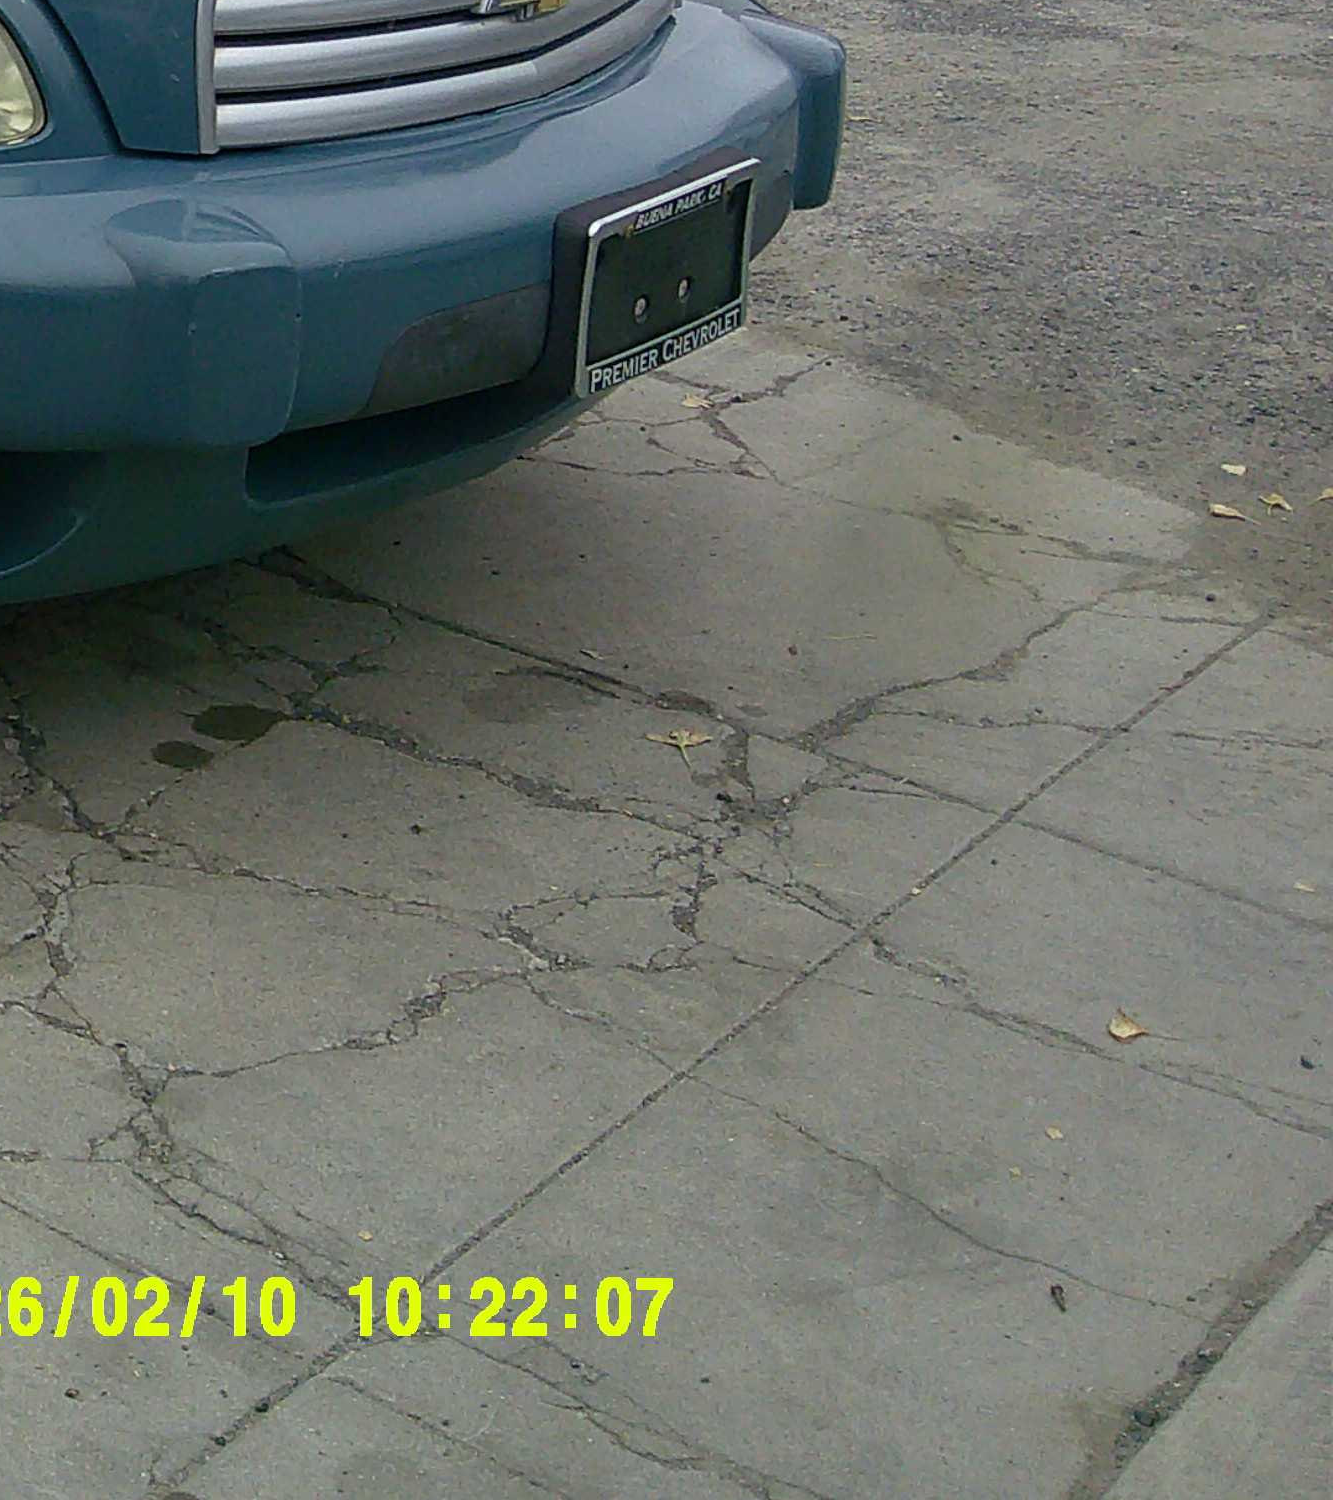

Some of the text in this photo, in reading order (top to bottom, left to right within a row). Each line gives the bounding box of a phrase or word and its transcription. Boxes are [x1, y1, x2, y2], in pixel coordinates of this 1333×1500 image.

[635, 203, 674, 230] BUENA
[590, 307, 741, 394] PREMIER CHEVROLET
